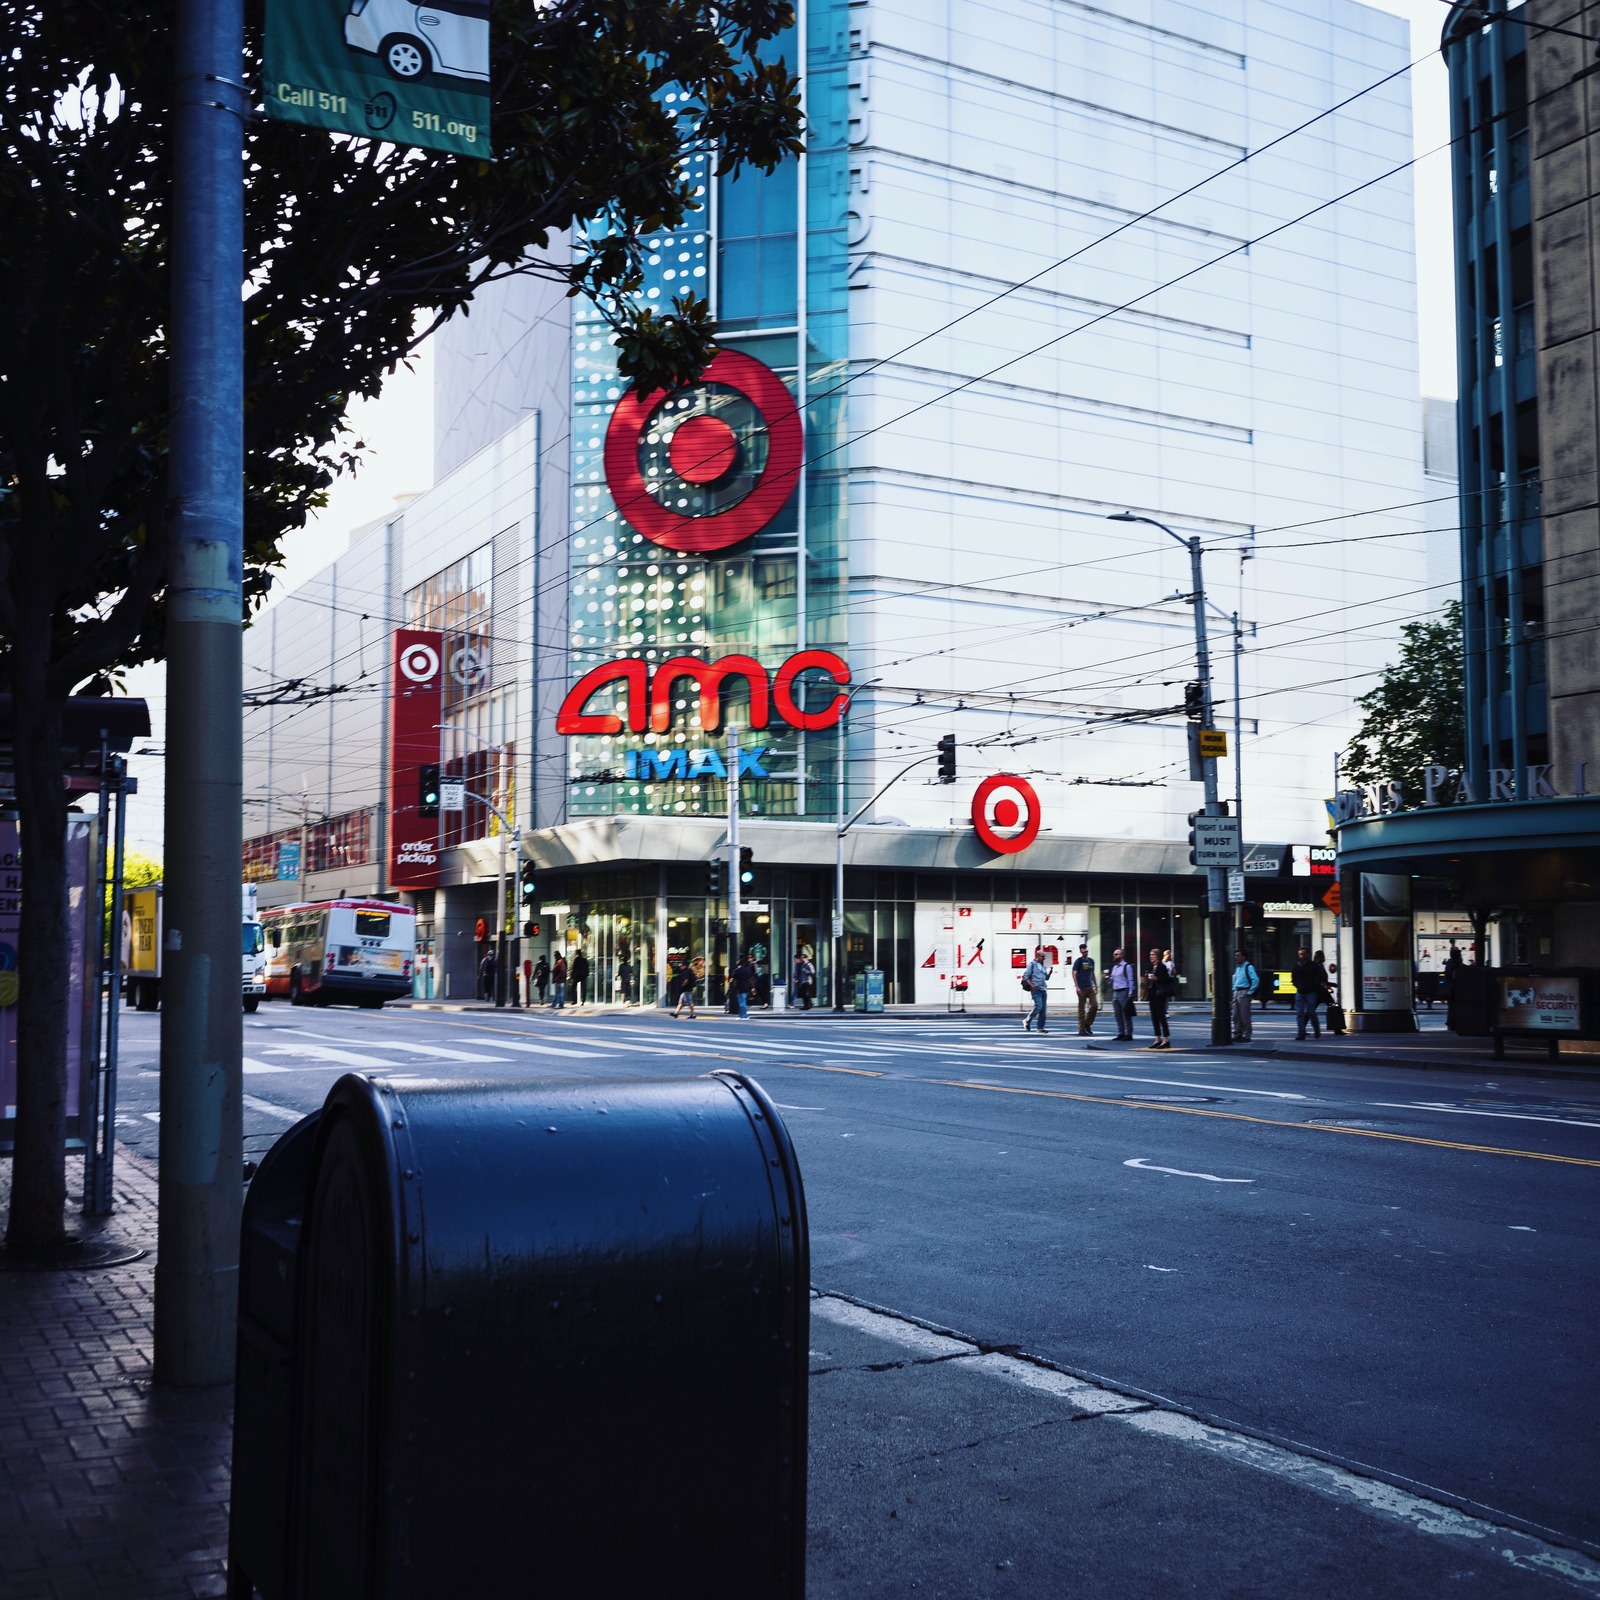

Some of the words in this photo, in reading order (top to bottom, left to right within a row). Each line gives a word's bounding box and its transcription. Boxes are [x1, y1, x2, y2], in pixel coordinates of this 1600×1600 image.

[277, 83, 315, 107] Call
[319, 91, 347, 114] 511
[364, 103, 389, 119] 511
[412, 110, 477, 143] 511.org
[829, 0, 871, 291] ETREON
[625, 747, 769, 781] IMAX
[1197, 824, 1217, 832] RIGHT
[1218, 824, 1238, 832] LANE
[401, 840, 434, 852] order
[1203, 837, 1232, 846] MUST
[397, 852, 437, 866] pickup
[1198, 851, 1217, 859] TURN
[1218, 851, 1239, 859] RIGHT
[1245, 861, 1277, 870] MISSION
[1263, 900, 1314, 913] openhouse
[1535, 1001, 1578, 1010] SECURITY
